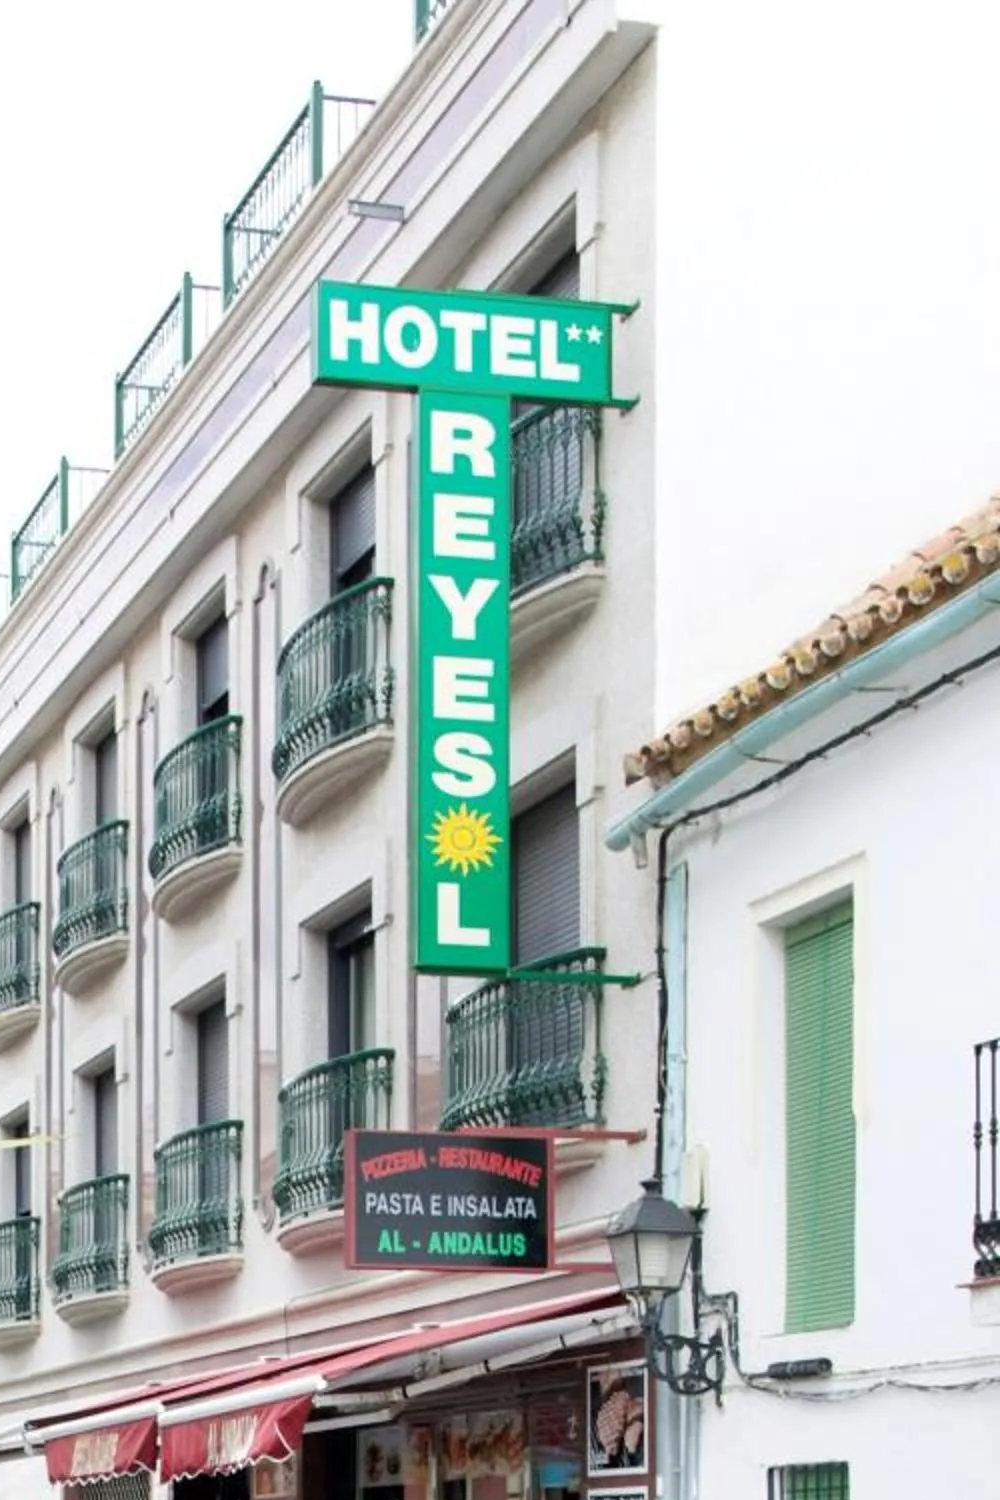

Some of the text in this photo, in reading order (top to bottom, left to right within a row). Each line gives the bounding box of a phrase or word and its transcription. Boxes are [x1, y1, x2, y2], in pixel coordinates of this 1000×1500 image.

[329, 299, 581, 381] HOTEL
[362, 1149, 427, 1181] PIZZERIA
[439, 1148, 542, 1186] RESTAURANTE
[365, 1192, 537, 1219] PASTA E INSALATA
[378, 1229, 406, 1253] AL
[427, 1231, 527, 1257] ANDALUS
